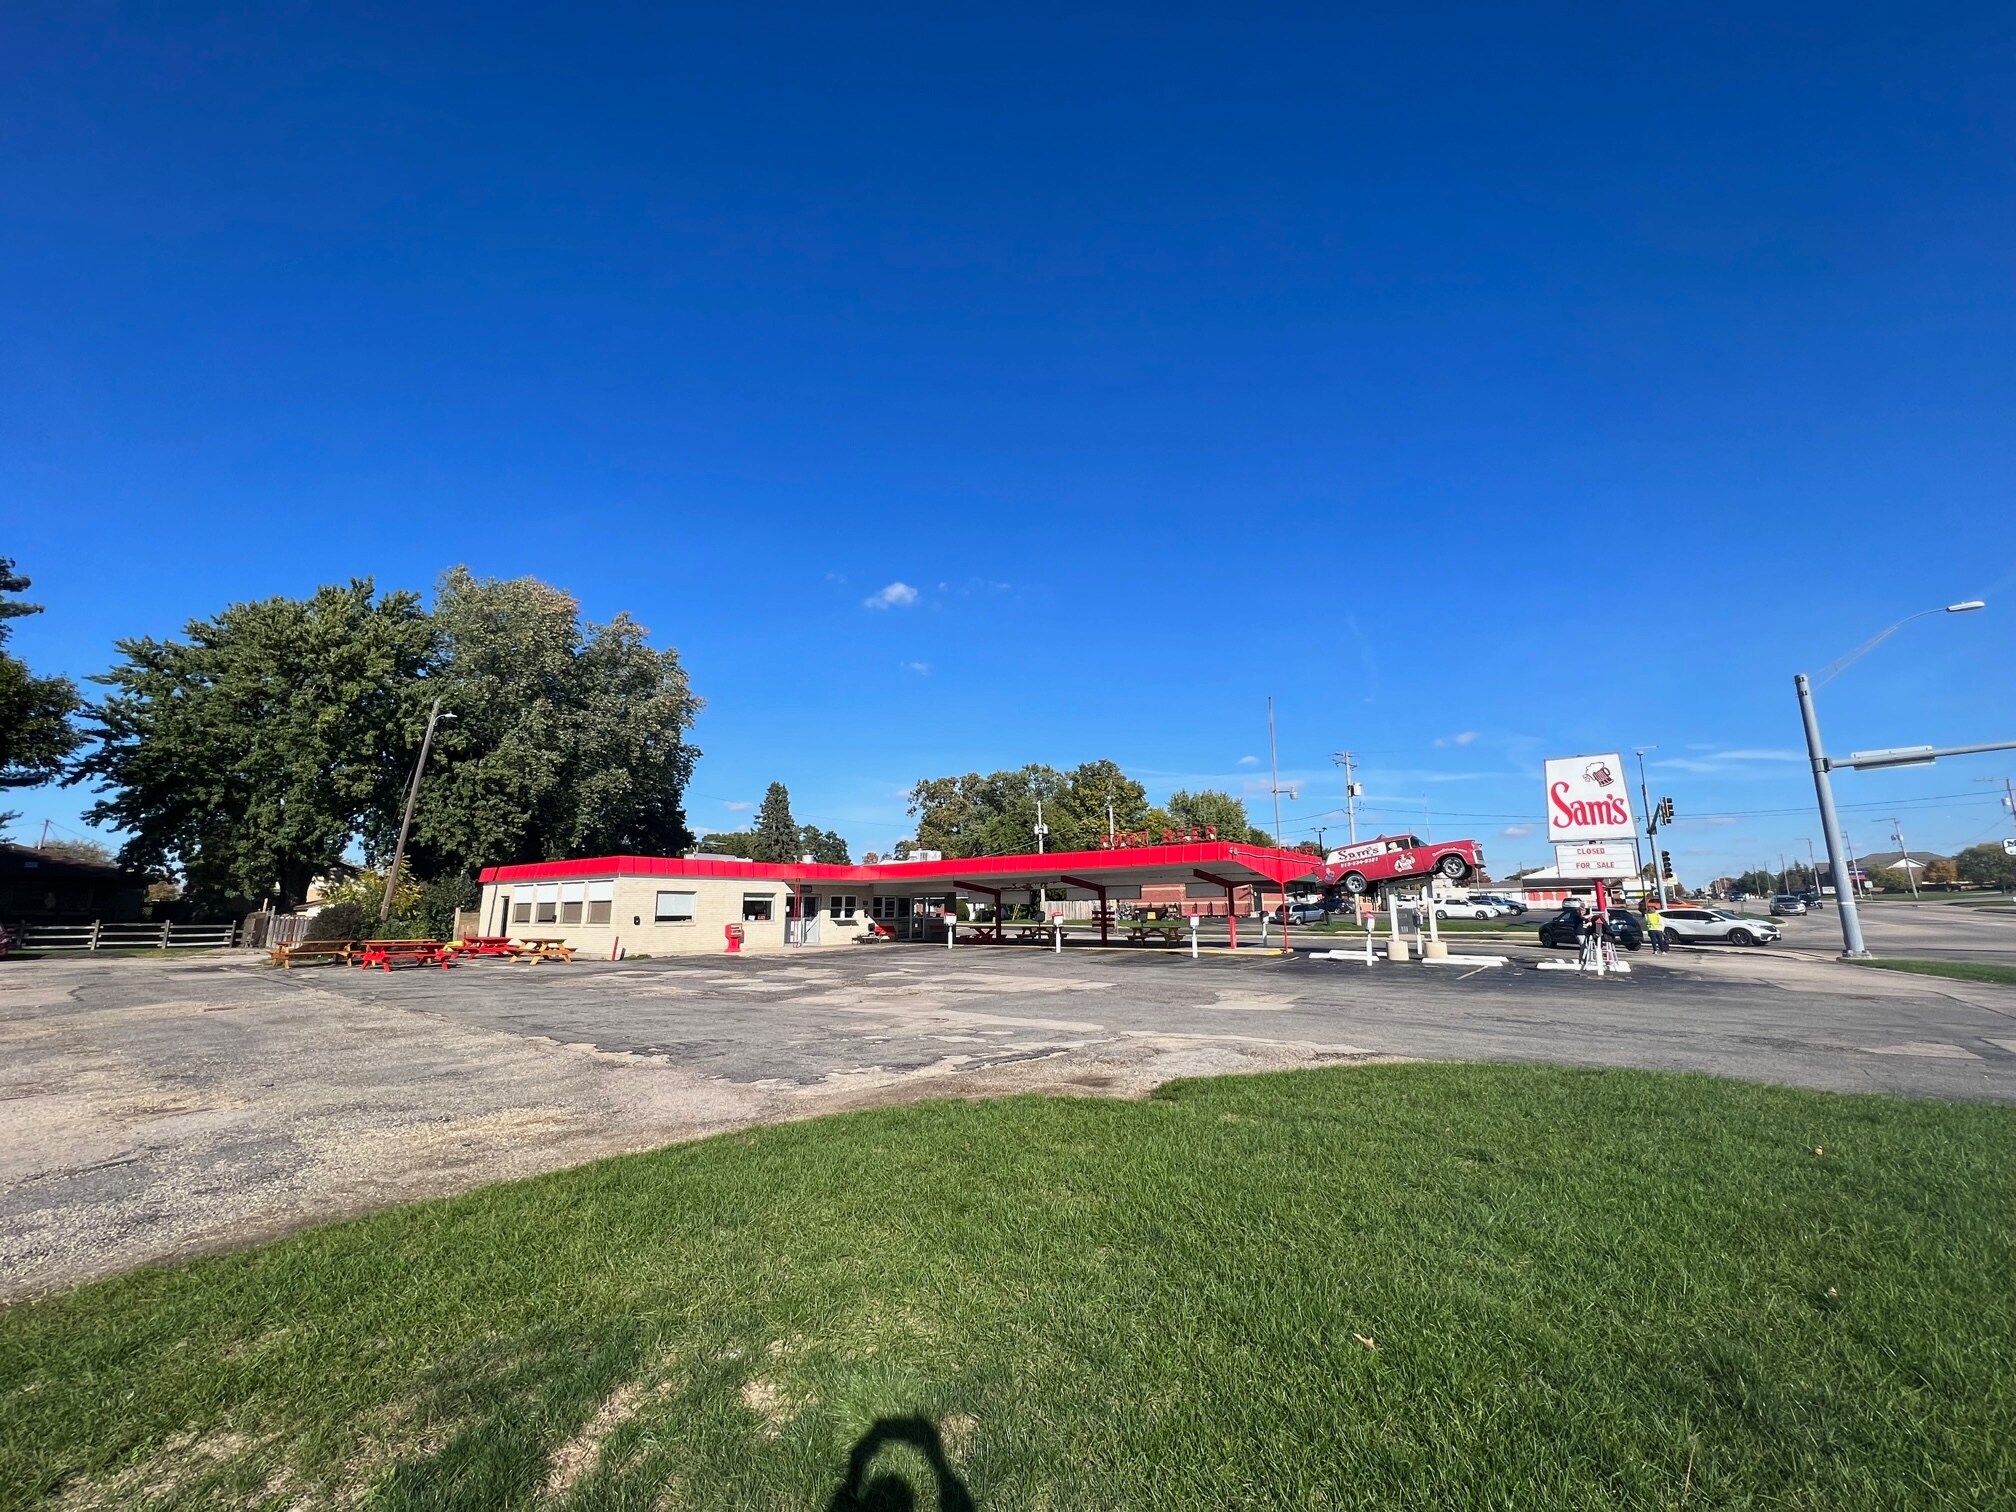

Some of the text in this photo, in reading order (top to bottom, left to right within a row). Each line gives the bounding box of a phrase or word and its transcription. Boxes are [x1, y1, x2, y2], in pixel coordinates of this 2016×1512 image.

[1550, 781, 1628, 829] Sam's
[1576, 847, 1605, 855] CLOSED
[1596, 861, 1615, 869] SALE
